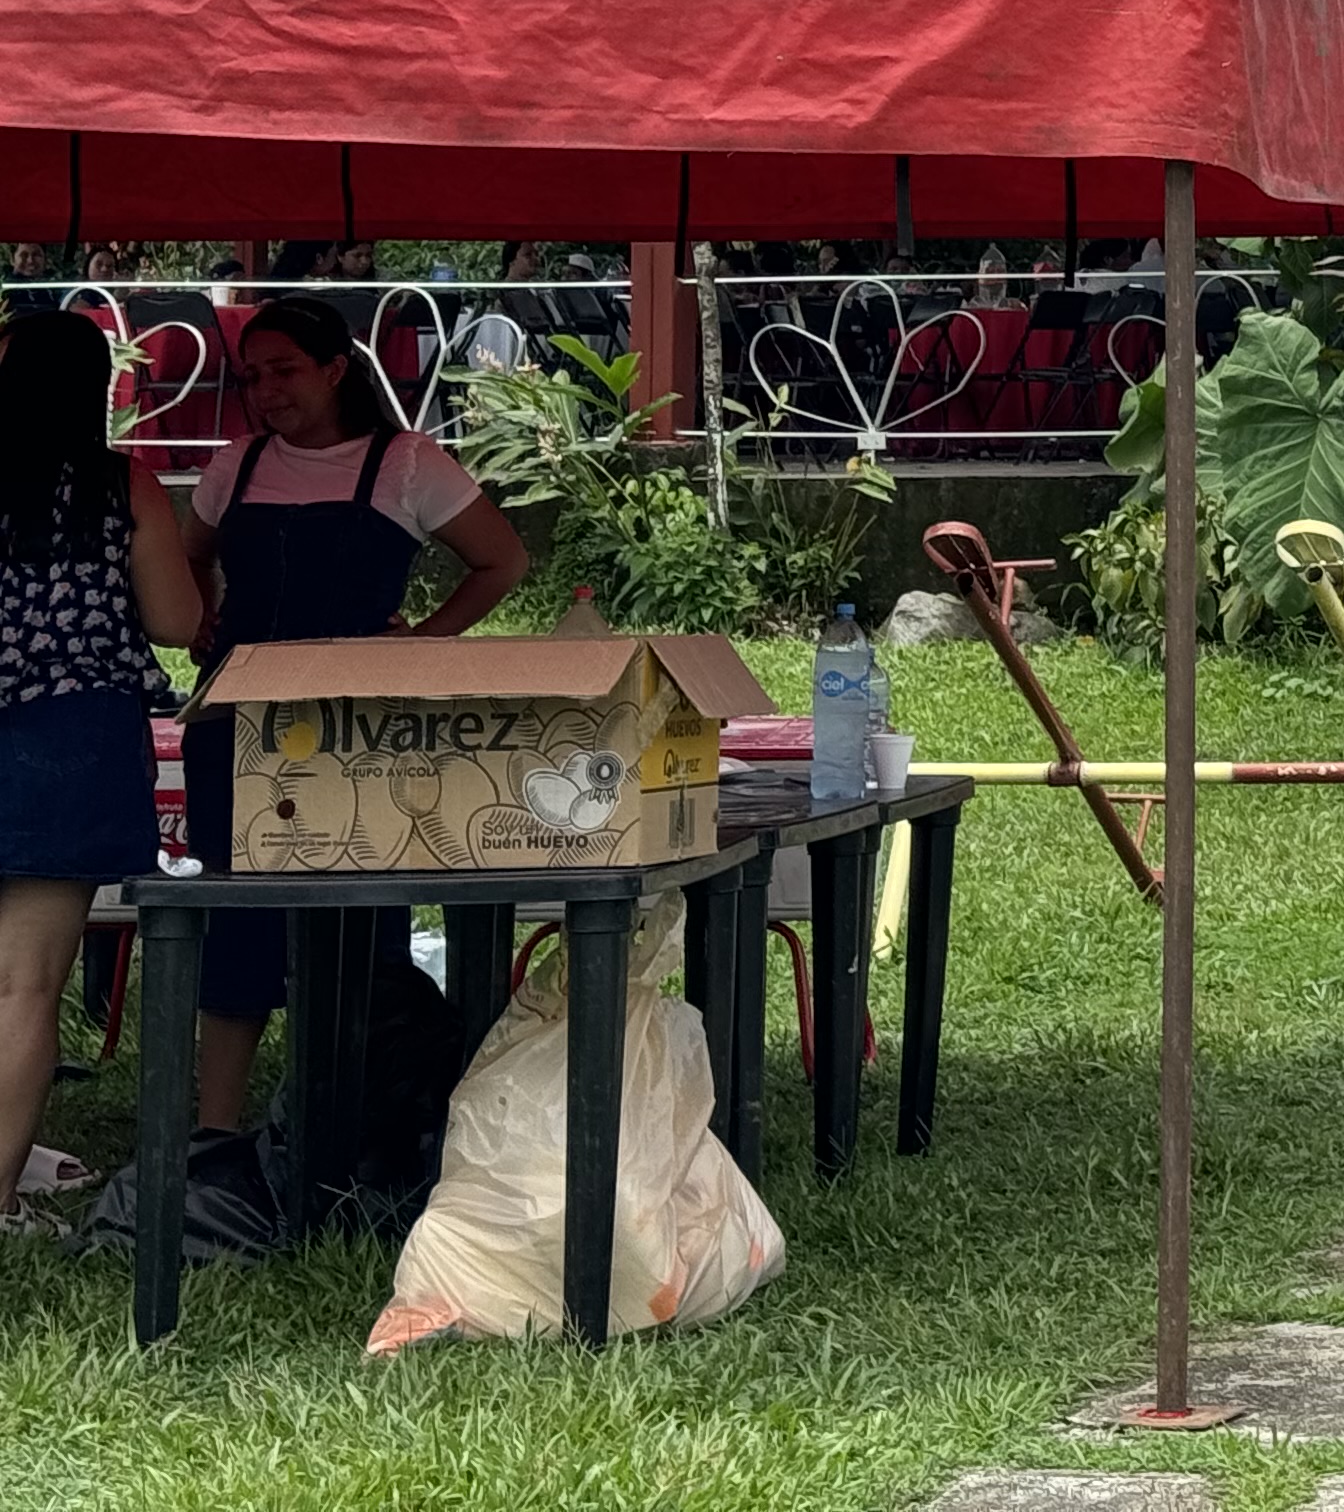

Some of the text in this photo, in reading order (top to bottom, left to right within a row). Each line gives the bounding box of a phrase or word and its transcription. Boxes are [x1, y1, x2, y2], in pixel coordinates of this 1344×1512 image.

[821, 675, 845, 691] ciel
[665, 719, 702, 739] HUEVOS
[341, 766, 384, 779] GRUPO
[482, 820, 514, 840] Soy
[526, 834, 589, 849] HUEVO
